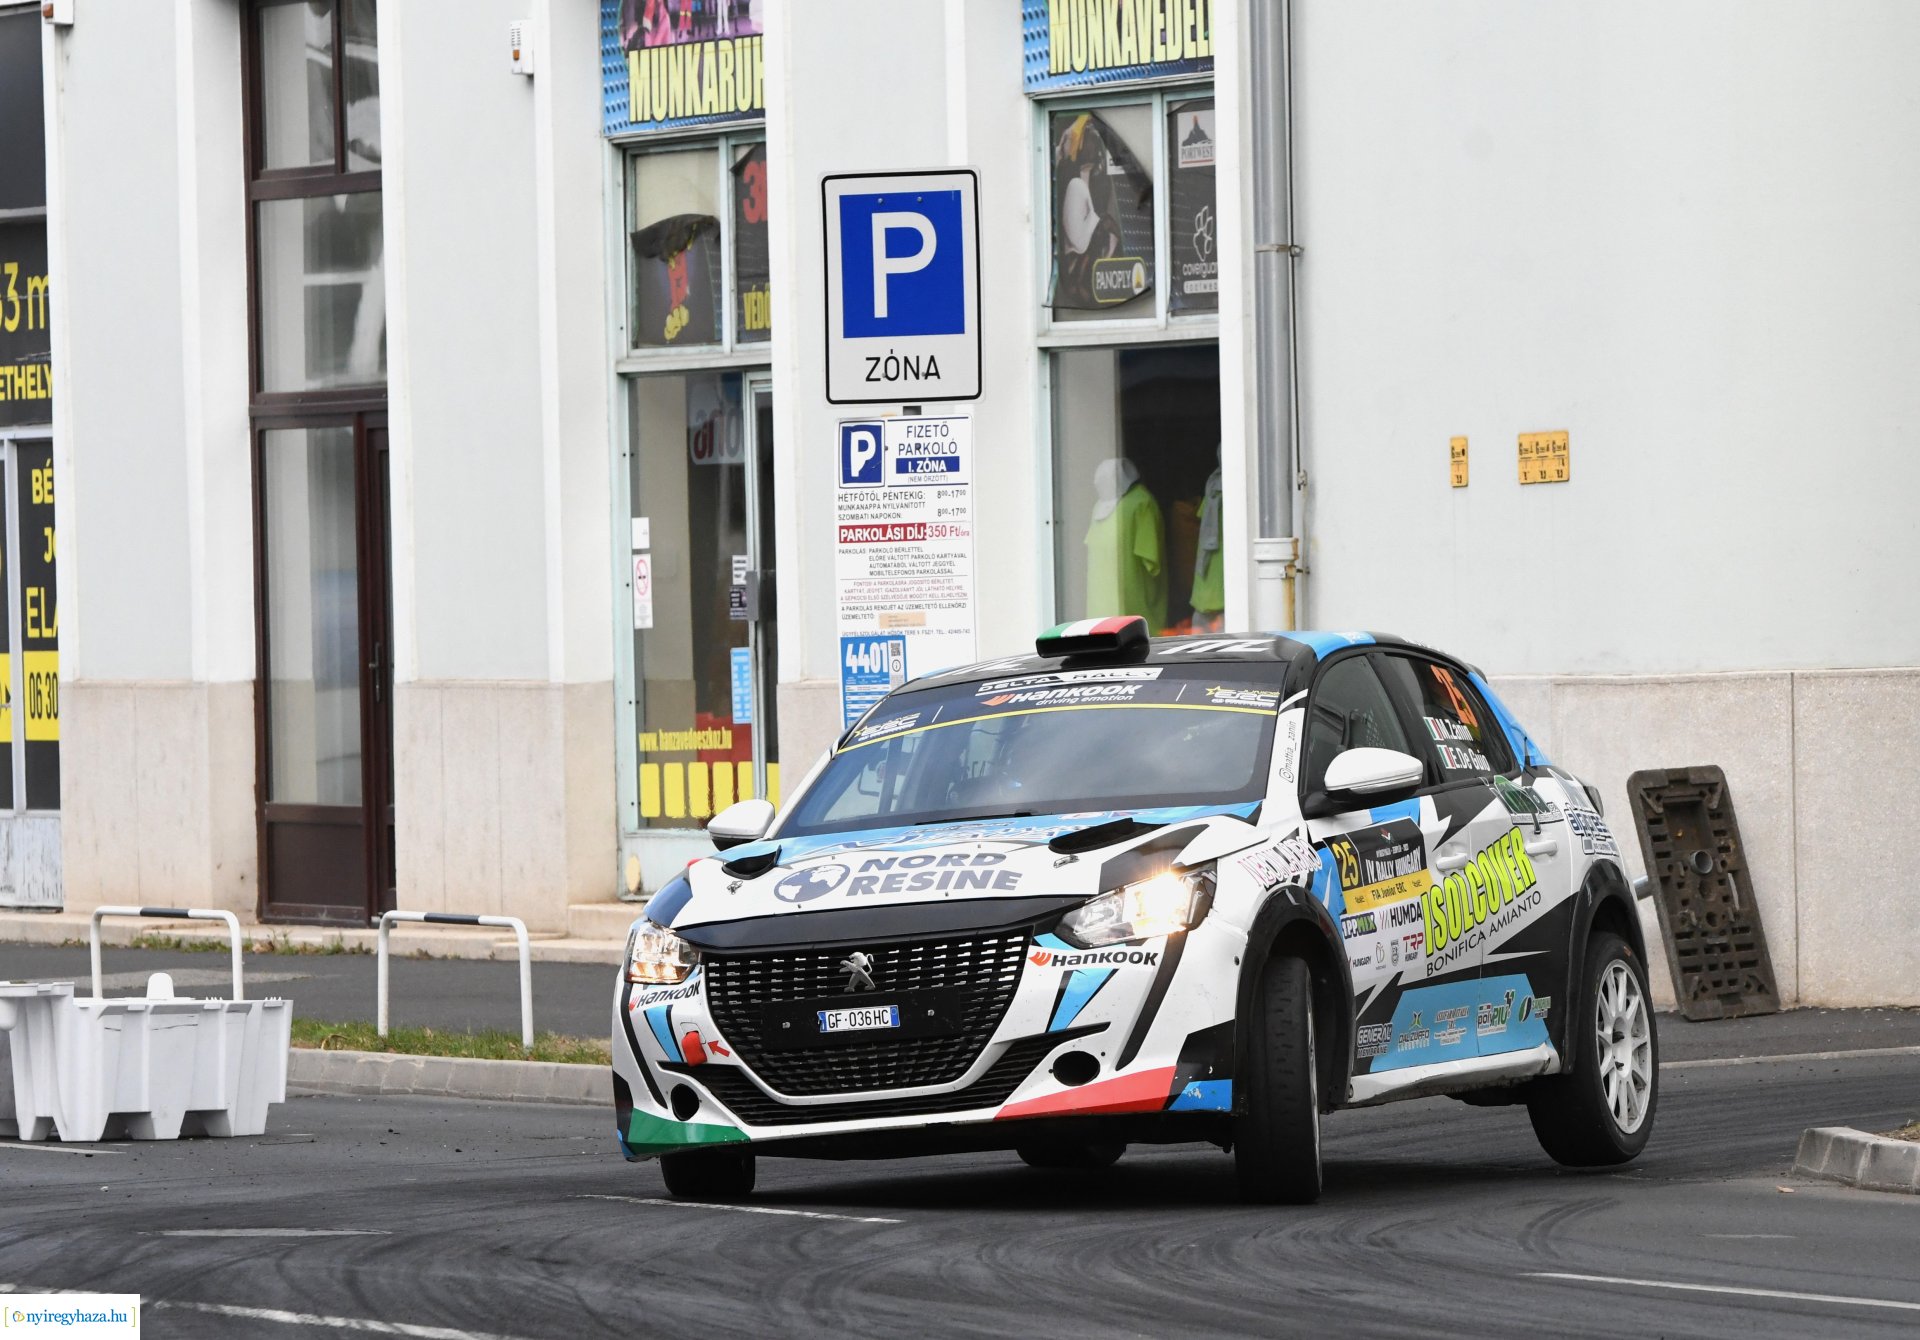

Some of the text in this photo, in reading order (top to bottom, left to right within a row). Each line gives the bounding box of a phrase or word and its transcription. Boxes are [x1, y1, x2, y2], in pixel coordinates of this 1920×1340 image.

[871, 211, 937, 318] P
[1095, 270, 1131, 290] PANOPLY
[865, 349, 941, 382] ZÓNA
[906, 421, 949, 438] FIZETŐ
[850, 430, 876, 477] P
[898, 438, 957, 456] PARKOLÓ
[916, 457, 947, 472] ZÓNA
[840, 524, 904, 542] PARKOLÁSI
[928, 524, 947, 538] 350
[845, 641, 889, 674] 4401
[29, 671, 42, 720] 06
[45, 671, 58, 720] 30
[1035, 695, 1133, 706] driving emotion
[858, 852, 1008, 873] NORD
[1332, 841, 1359, 888] 25
[1375, 859, 1394, 882] RALLY
[1394, 846, 1422, 877] HUNGARY
[845, 869, 1023, 897] RESINE
[1371, 888, 1381, 900] FIA
[1382, 885, 1396, 899] Junior
[1419, 826, 1537, 957] ISOLCOVER
[1390, 902, 1423, 928] HUMDA
[1403, 932, 1424, 953] TRP
[1426, 890, 1542, 977] BONIFICA AMIANTO
